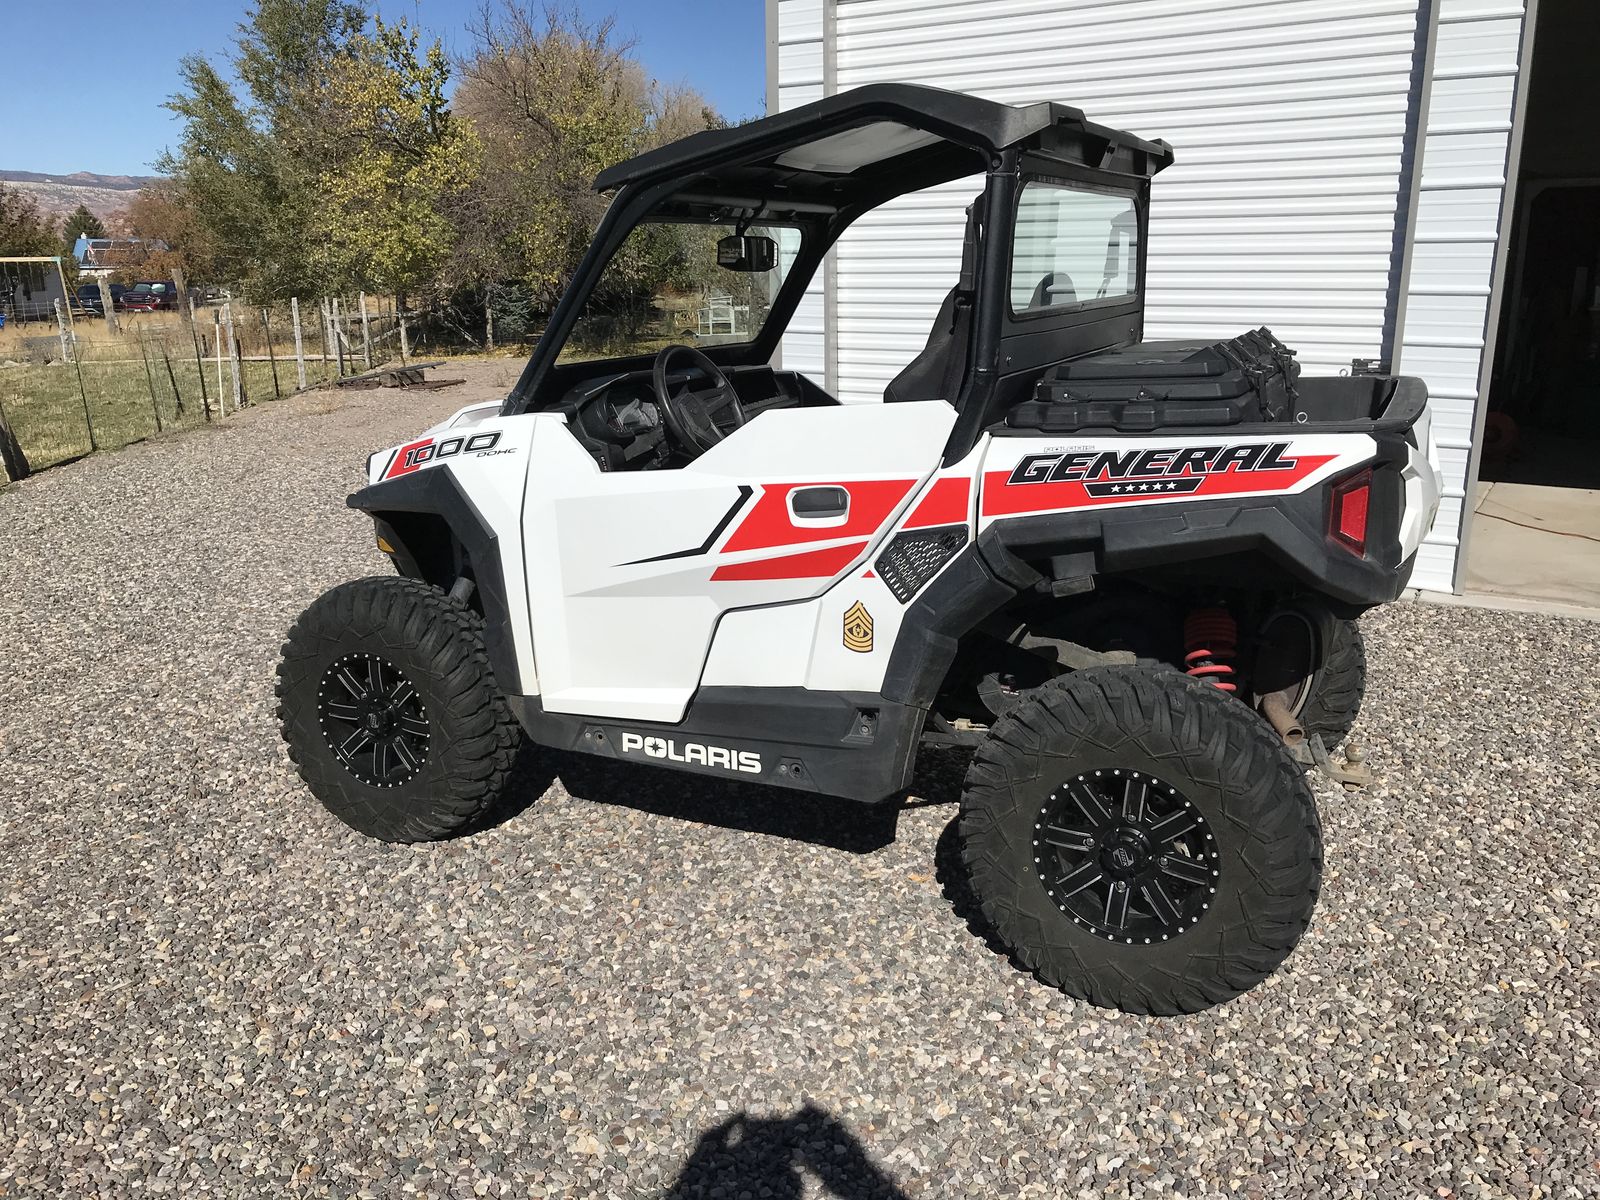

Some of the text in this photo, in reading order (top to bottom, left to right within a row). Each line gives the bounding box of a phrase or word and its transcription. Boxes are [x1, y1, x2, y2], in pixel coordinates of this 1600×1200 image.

[404, 431, 502, 468] 1000
[476, 447, 518, 458] DOHC
[1006, 441, 1297, 486] GENERAL
[622, 732, 762, 774] POLARIS
